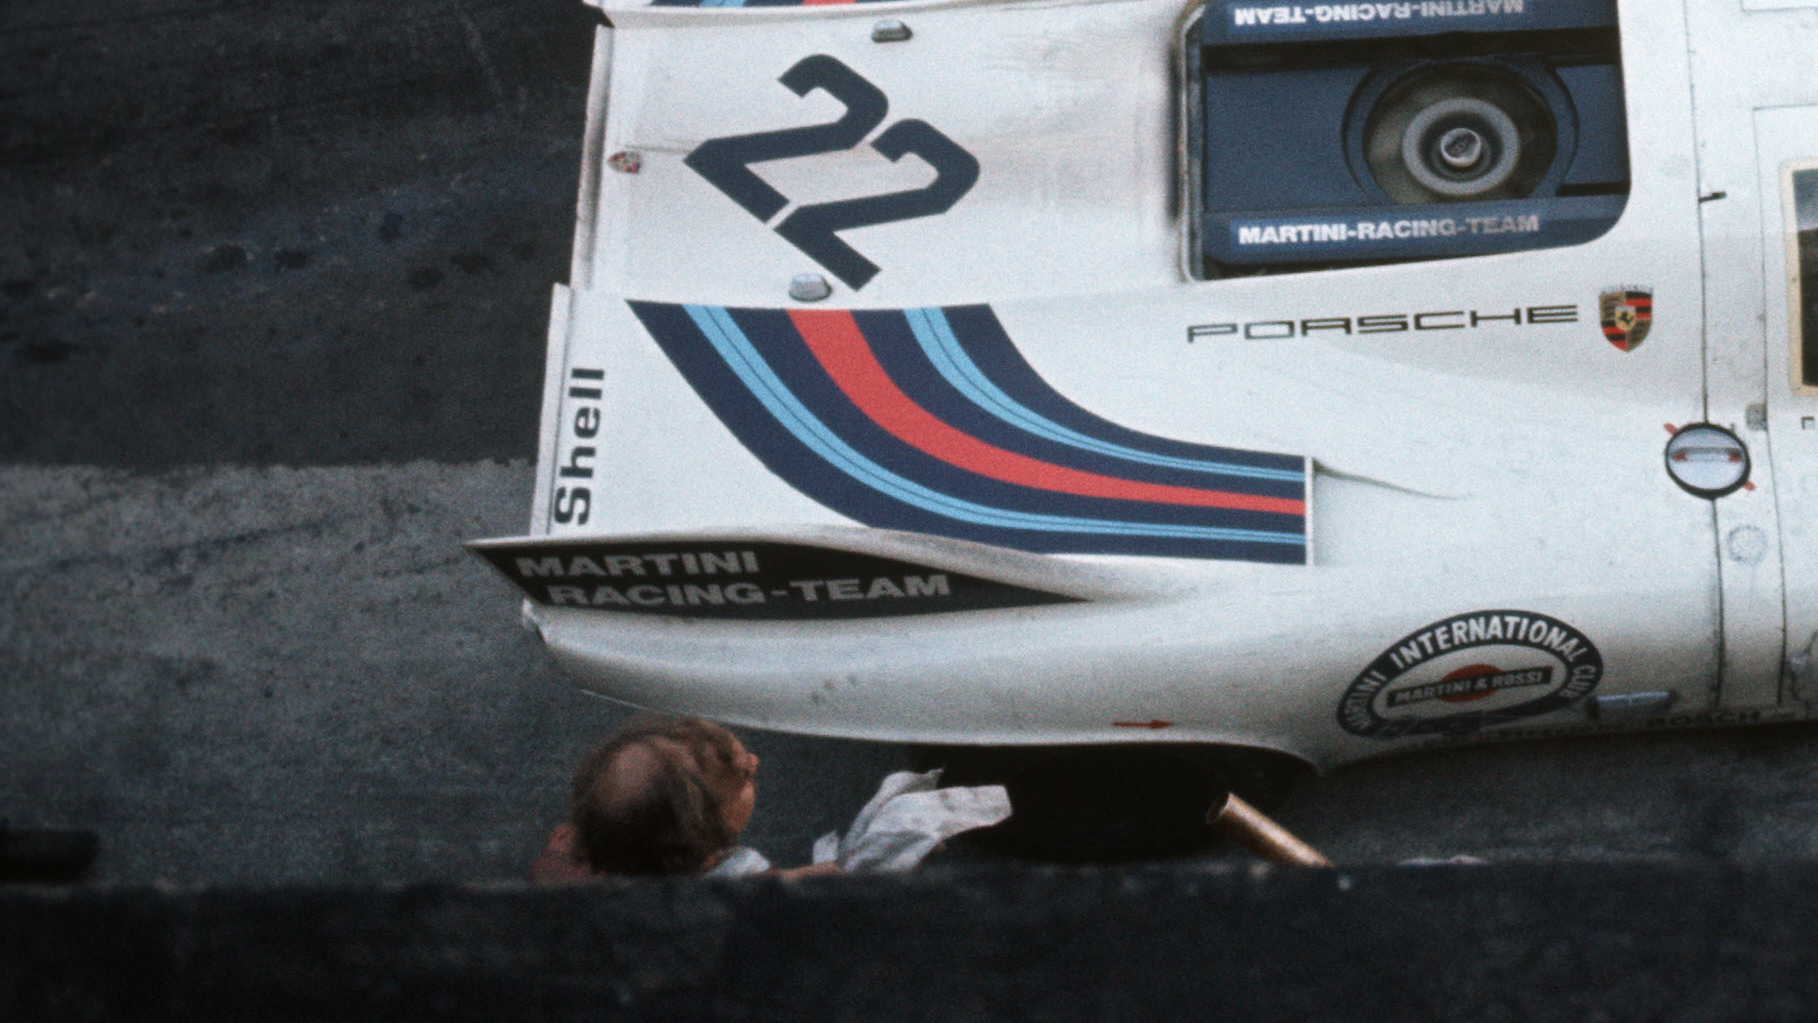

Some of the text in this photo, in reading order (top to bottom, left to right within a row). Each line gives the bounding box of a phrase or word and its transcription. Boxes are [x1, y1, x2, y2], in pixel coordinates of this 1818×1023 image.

[682, 53, 981, 292] 22
[1237, 214, 1539, 245] MARTINI-RACING-TEAM
[1186, 305, 1579, 343] PORSCHE
[553, 366, 605, 526] Shell
[515, 551, 760, 577] MARTINI
[544, 574, 951, 607] RACING-TEAM
[1390, 614, 1588, 668] INTERNATIONAL
[1394, 670, 1544, 703] MARTINI & ROSSI
